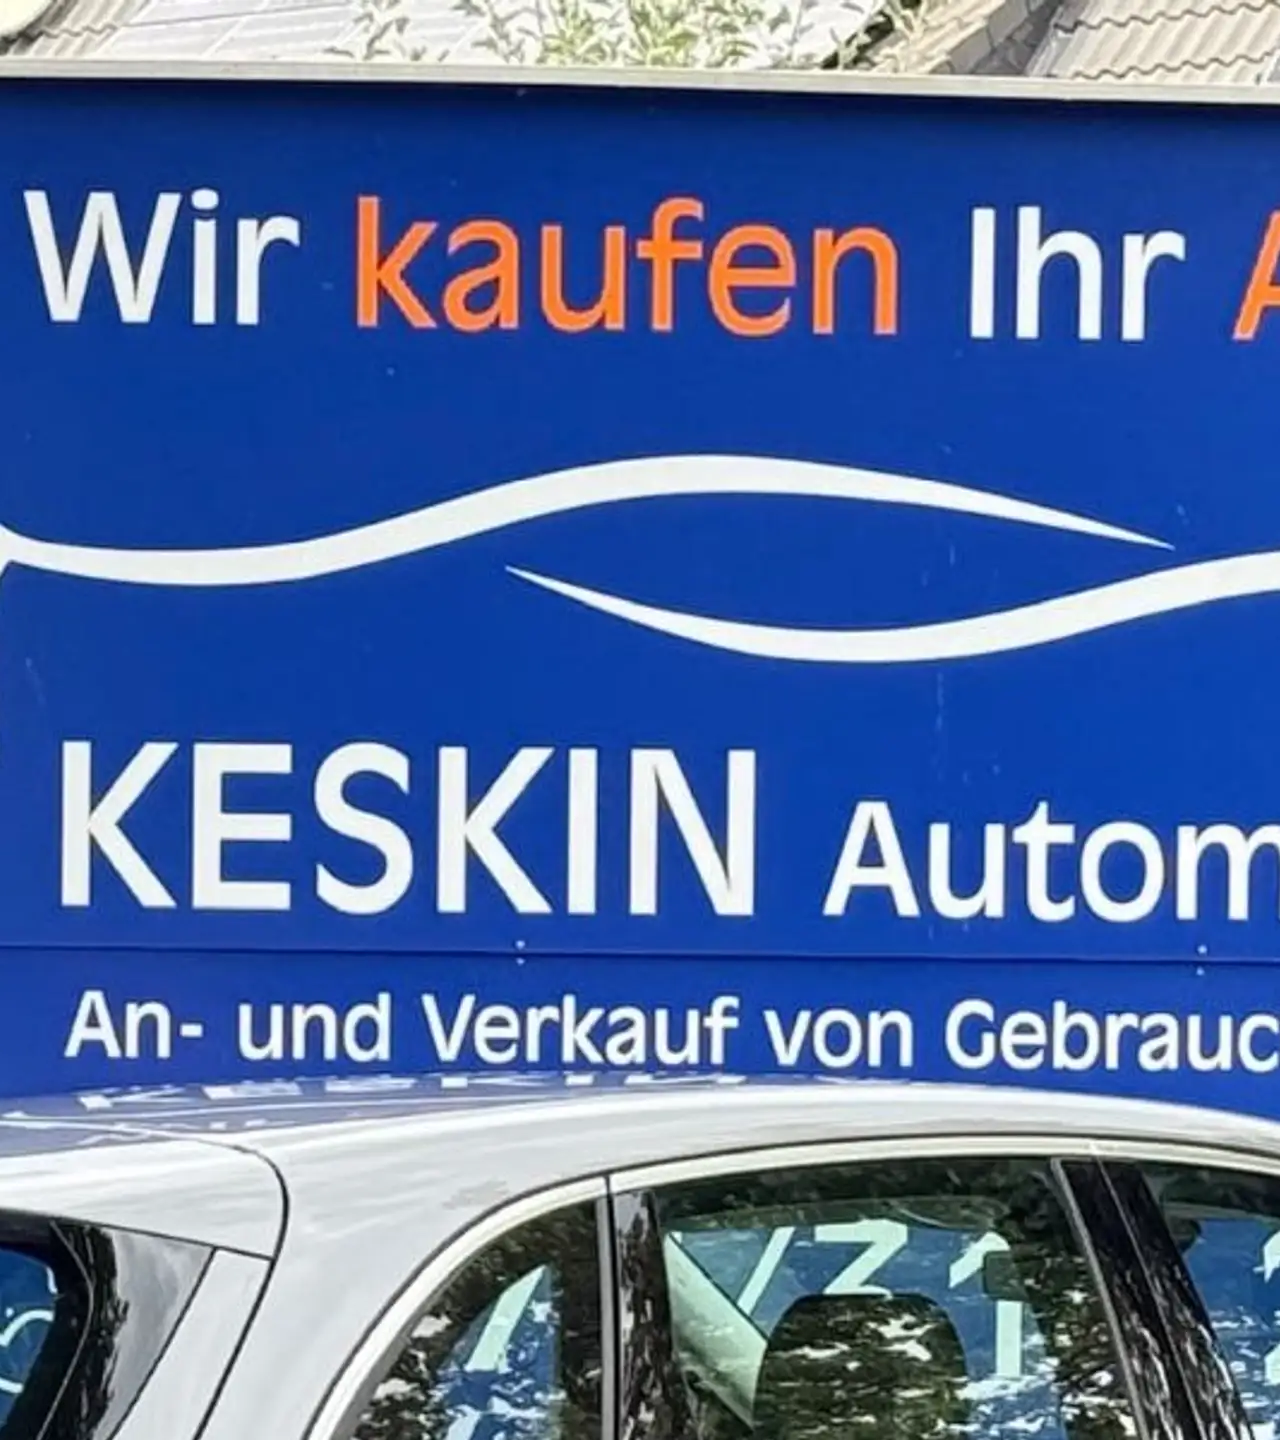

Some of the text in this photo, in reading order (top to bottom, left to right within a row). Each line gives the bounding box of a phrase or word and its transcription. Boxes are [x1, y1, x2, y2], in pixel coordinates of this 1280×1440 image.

[23, 190, 300, 325] Wir
[356, 195, 898, 338] kaufen
[970, 206, 1186, 342] Ihr
[61, 741, 756, 916] KESKIN
[64, 990, 203, 1060] An-
[238, 992, 391, 1062] und
[421, 993, 740, 1066] Verkauf
[763, 1009, 913, 1069] von
